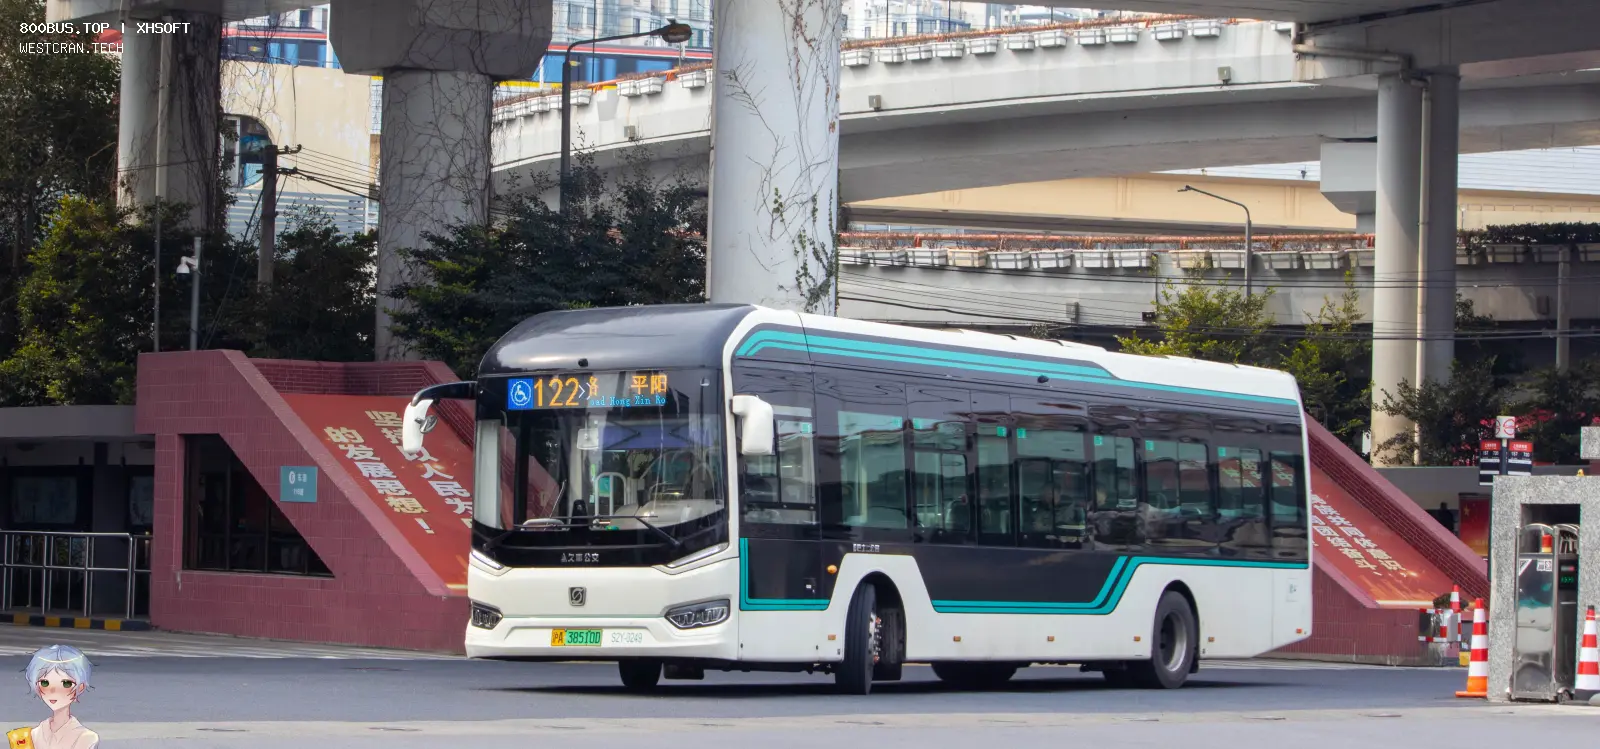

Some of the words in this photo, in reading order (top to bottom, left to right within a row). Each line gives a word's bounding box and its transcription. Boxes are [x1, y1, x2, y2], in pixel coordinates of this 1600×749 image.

[534, 377, 580, 407] 122
[631, 374, 668, 395] 平阳
[609, 396, 631, 407] Hong
[634, 395, 651, 405] Xin
